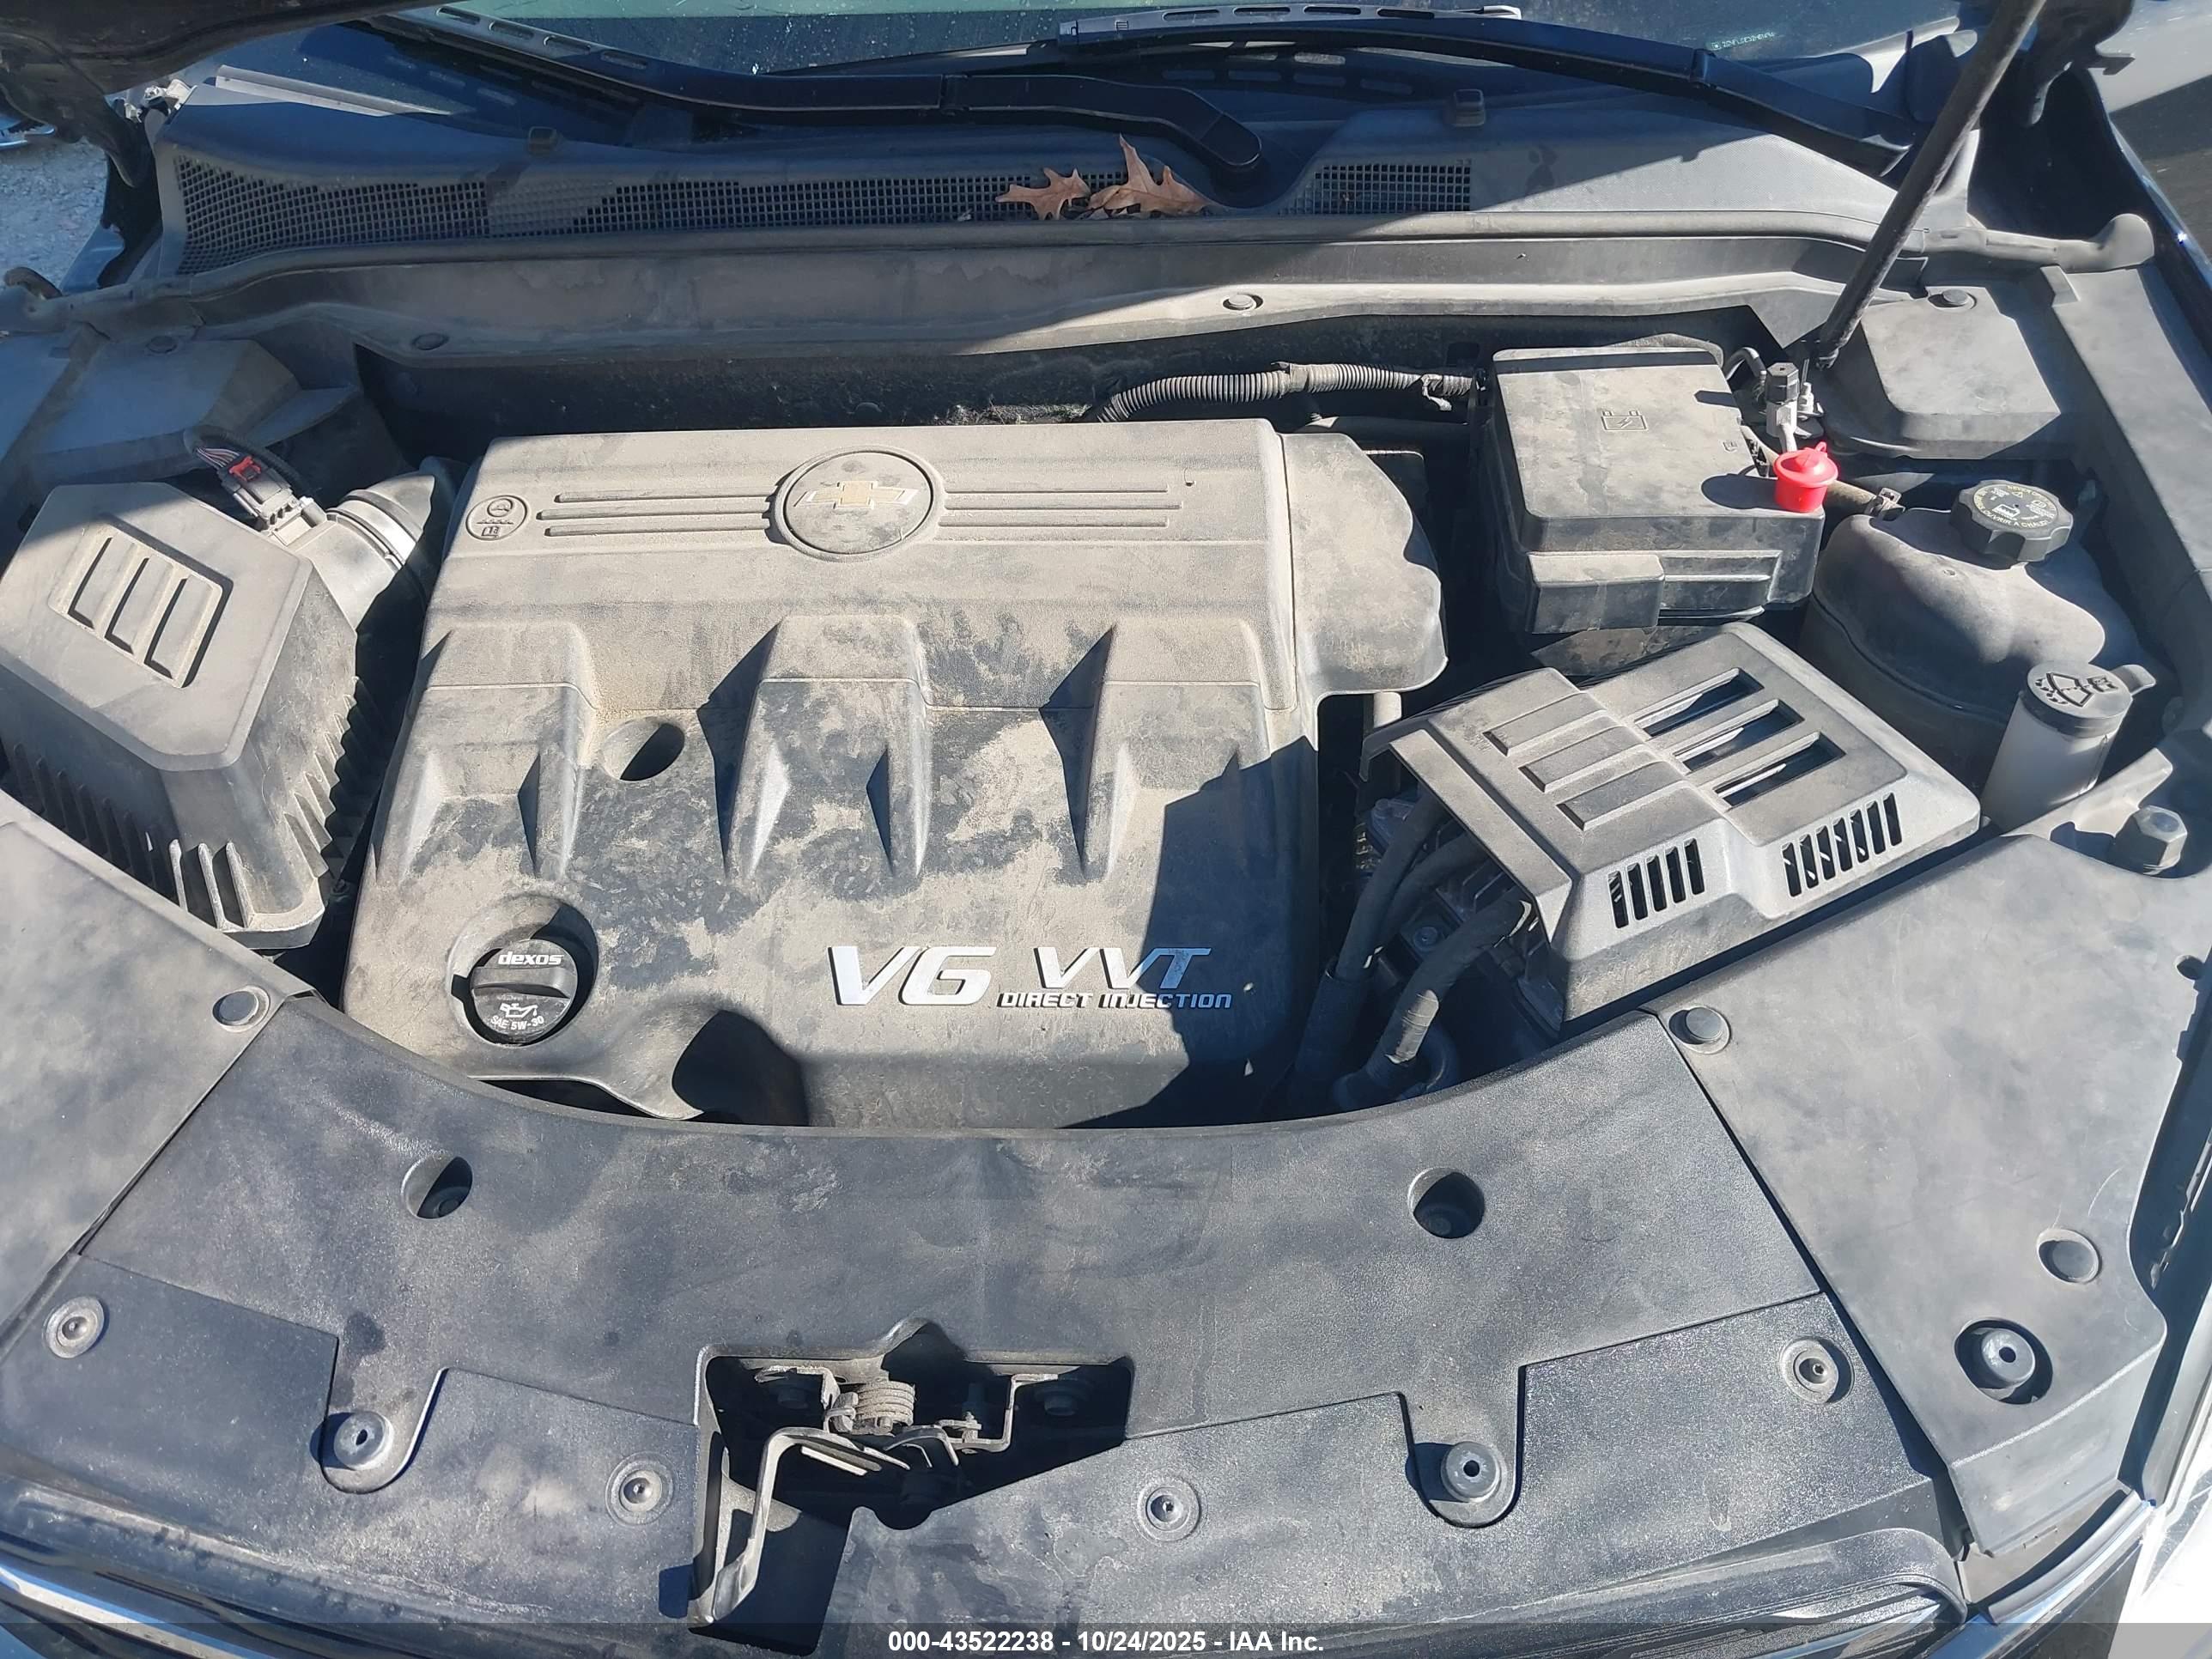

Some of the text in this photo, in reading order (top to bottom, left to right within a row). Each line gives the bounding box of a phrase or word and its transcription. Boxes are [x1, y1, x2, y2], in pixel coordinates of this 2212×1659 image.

[498, 951, 563, 965] dexos
[830, 946, 1212, 1006] V6 VVT
[998, 993, 1232, 1009] DIRECT INJECTION
[490, 1015, 544, 1030] SAE 5W-30
